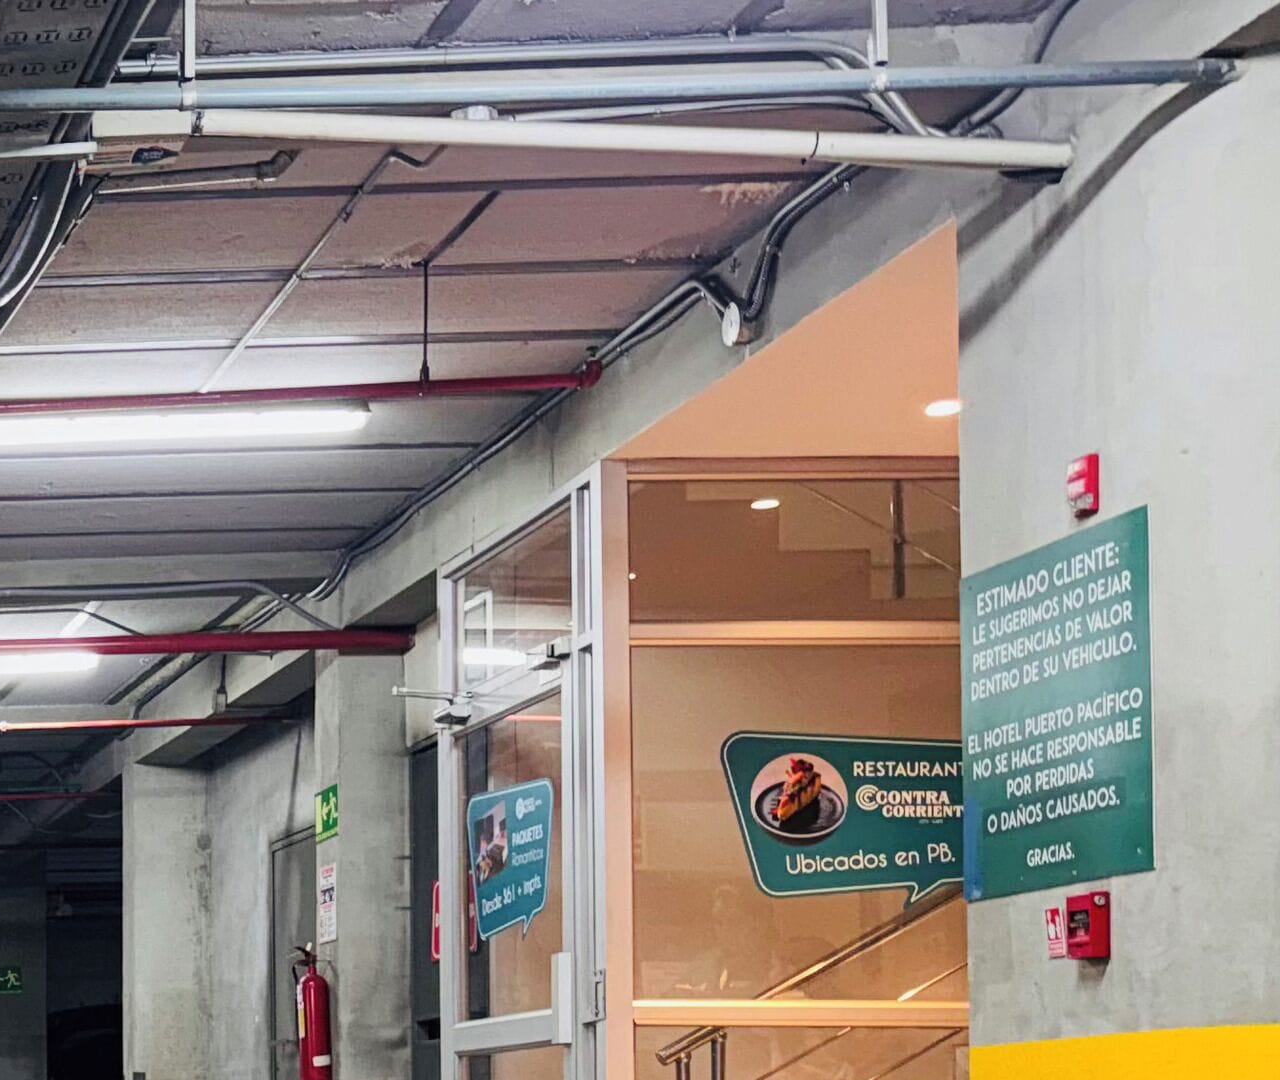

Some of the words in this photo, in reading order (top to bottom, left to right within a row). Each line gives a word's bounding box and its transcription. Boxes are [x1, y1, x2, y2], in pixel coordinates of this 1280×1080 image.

[976, 569, 1049, 616] ESTIMADO
[1053, 541, 1119, 586] CLIENTE:
[972, 623, 986, 646] LE
[989, 596, 1059, 640] SUGERIMOS
[1063, 587, 1085, 613] NO
[1088, 570, 1132, 604] DEJAR
[972, 624, 1061, 673] PERTENENCIAS
[1065, 617, 1082, 641] DE
[1086, 600, 1133, 634] VALOR
[971, 668, 1020, 702] DENTRO
[1023, 661, 1040, 685] DE
[1043, 654, 1059, 678] SU
[1062, 631, 1137, 671] VEHICULO.
[968, 733, 981, 755] EL
[984, 721, 1022, 750] HOTEL
[1025, 706, 1073, 739] PUERTO
[1077, 687, 1143, 724] PACÍFICO
[972, 757, 992, 781] NO
[994, 752, 1008, 775] SE
[1011, 742, 1043, 771] HACE
[1047, 717, 1142, 761] RESPONSABLE
[876, 790, 950, 805] CONTRA
[1006, 774, 1032, 799] POR
[1035, 758, 1094, 792] PERDIDAS
[882, 805, 964, 818] CORRIENT
[987, 813, 998, 834] O
[1001, 802, 1043, 831] DAÑOS
[1046, 785, 1120, 819] CAUSADOS.
[785, 849, 888, 875] Ubicados
[894, 850, 920, 867] en
[927, 842, 956, 863] PB.
[1027, 841, 1075, 867] GRACIAS.
